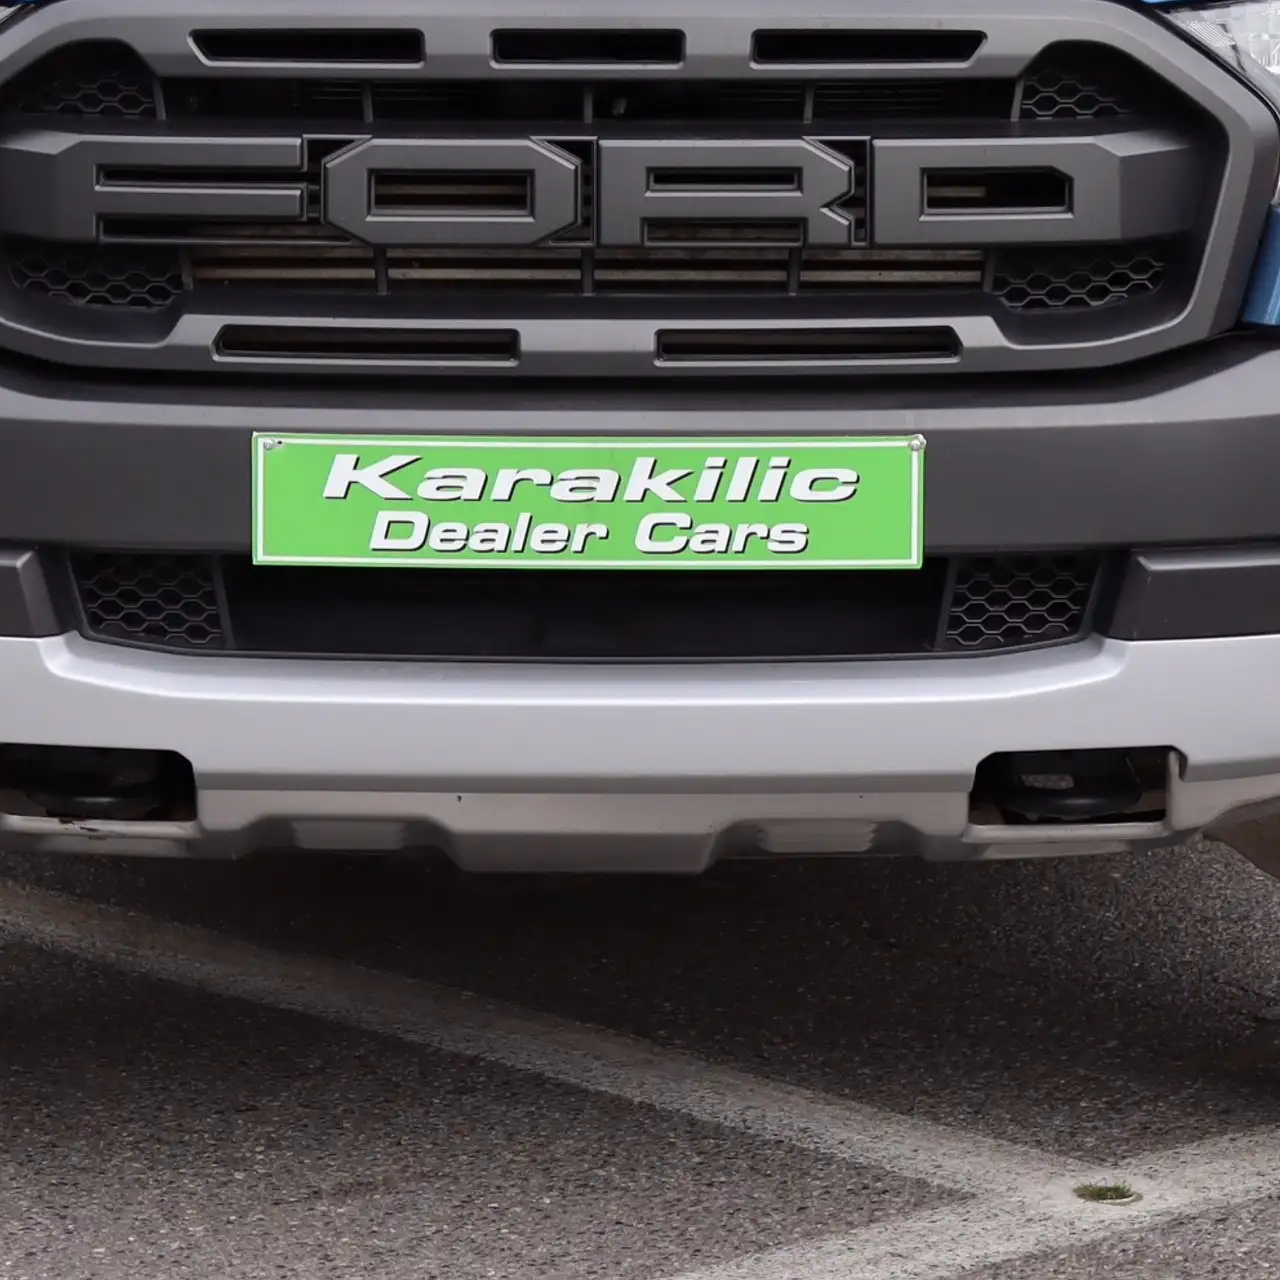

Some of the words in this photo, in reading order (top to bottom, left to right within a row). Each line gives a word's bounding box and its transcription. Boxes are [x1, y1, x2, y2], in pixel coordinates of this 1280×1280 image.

[322, 453, 860, 504] Karakilic
[368, 510, 608, 554] Dealer
[634, 512, 809, 554] Cars
